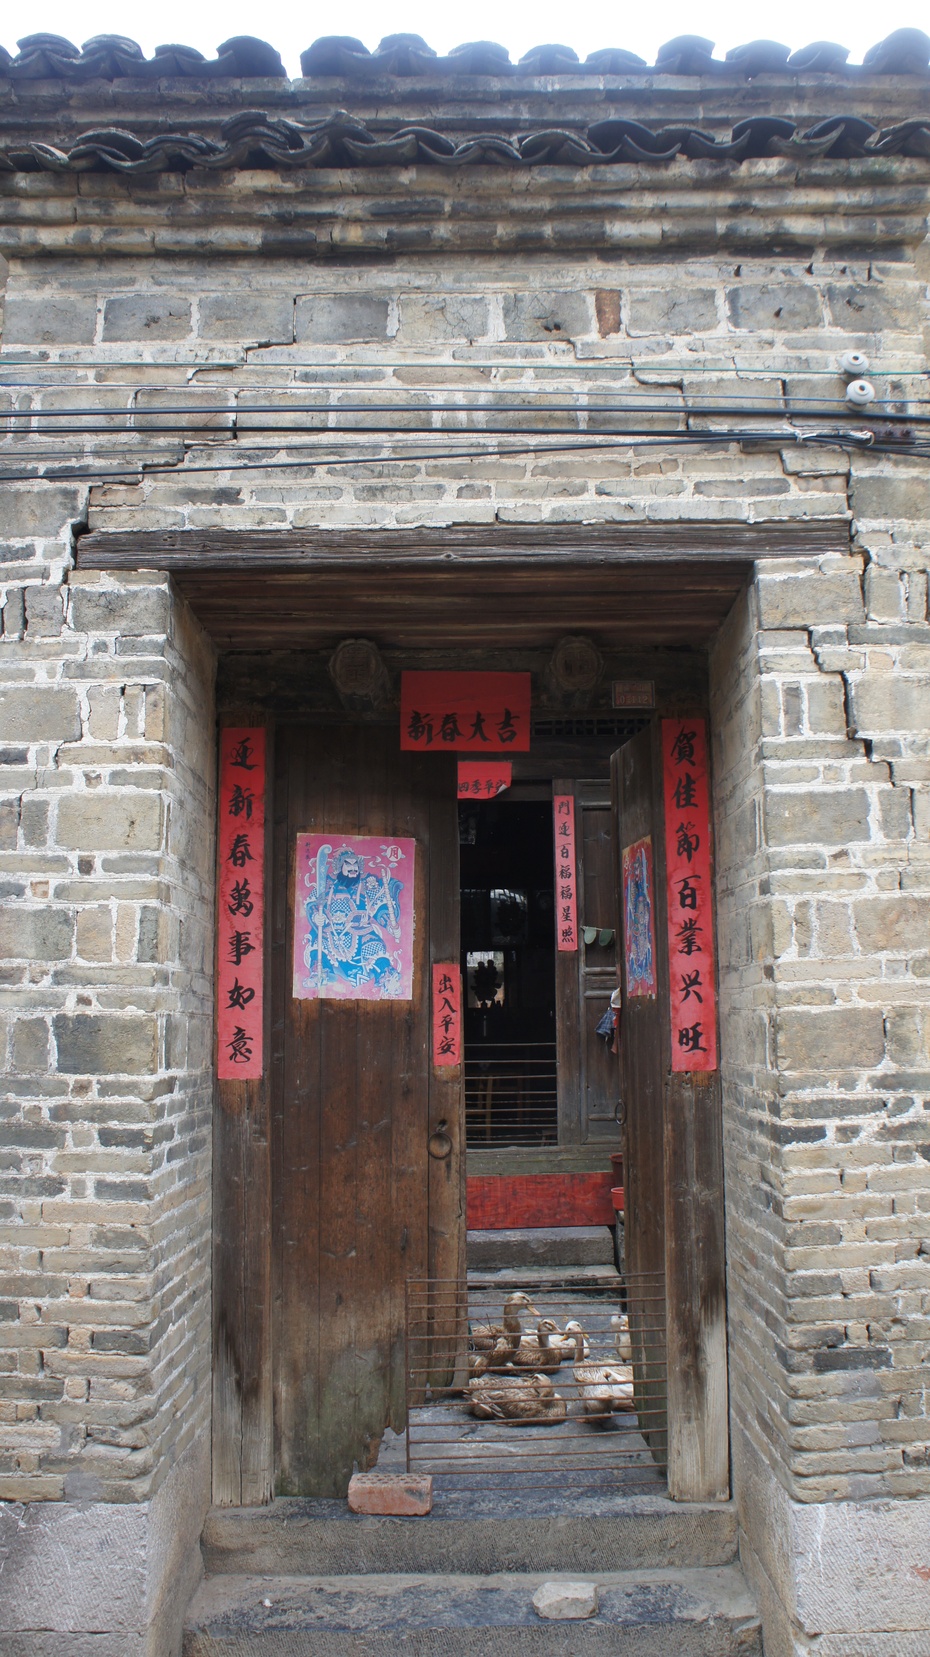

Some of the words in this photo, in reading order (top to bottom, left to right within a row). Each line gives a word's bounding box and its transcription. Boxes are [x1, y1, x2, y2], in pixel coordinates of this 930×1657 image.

[407, 708, 520, 745] 新春大吉
[437, 973, 457, 1055] 出入平安
